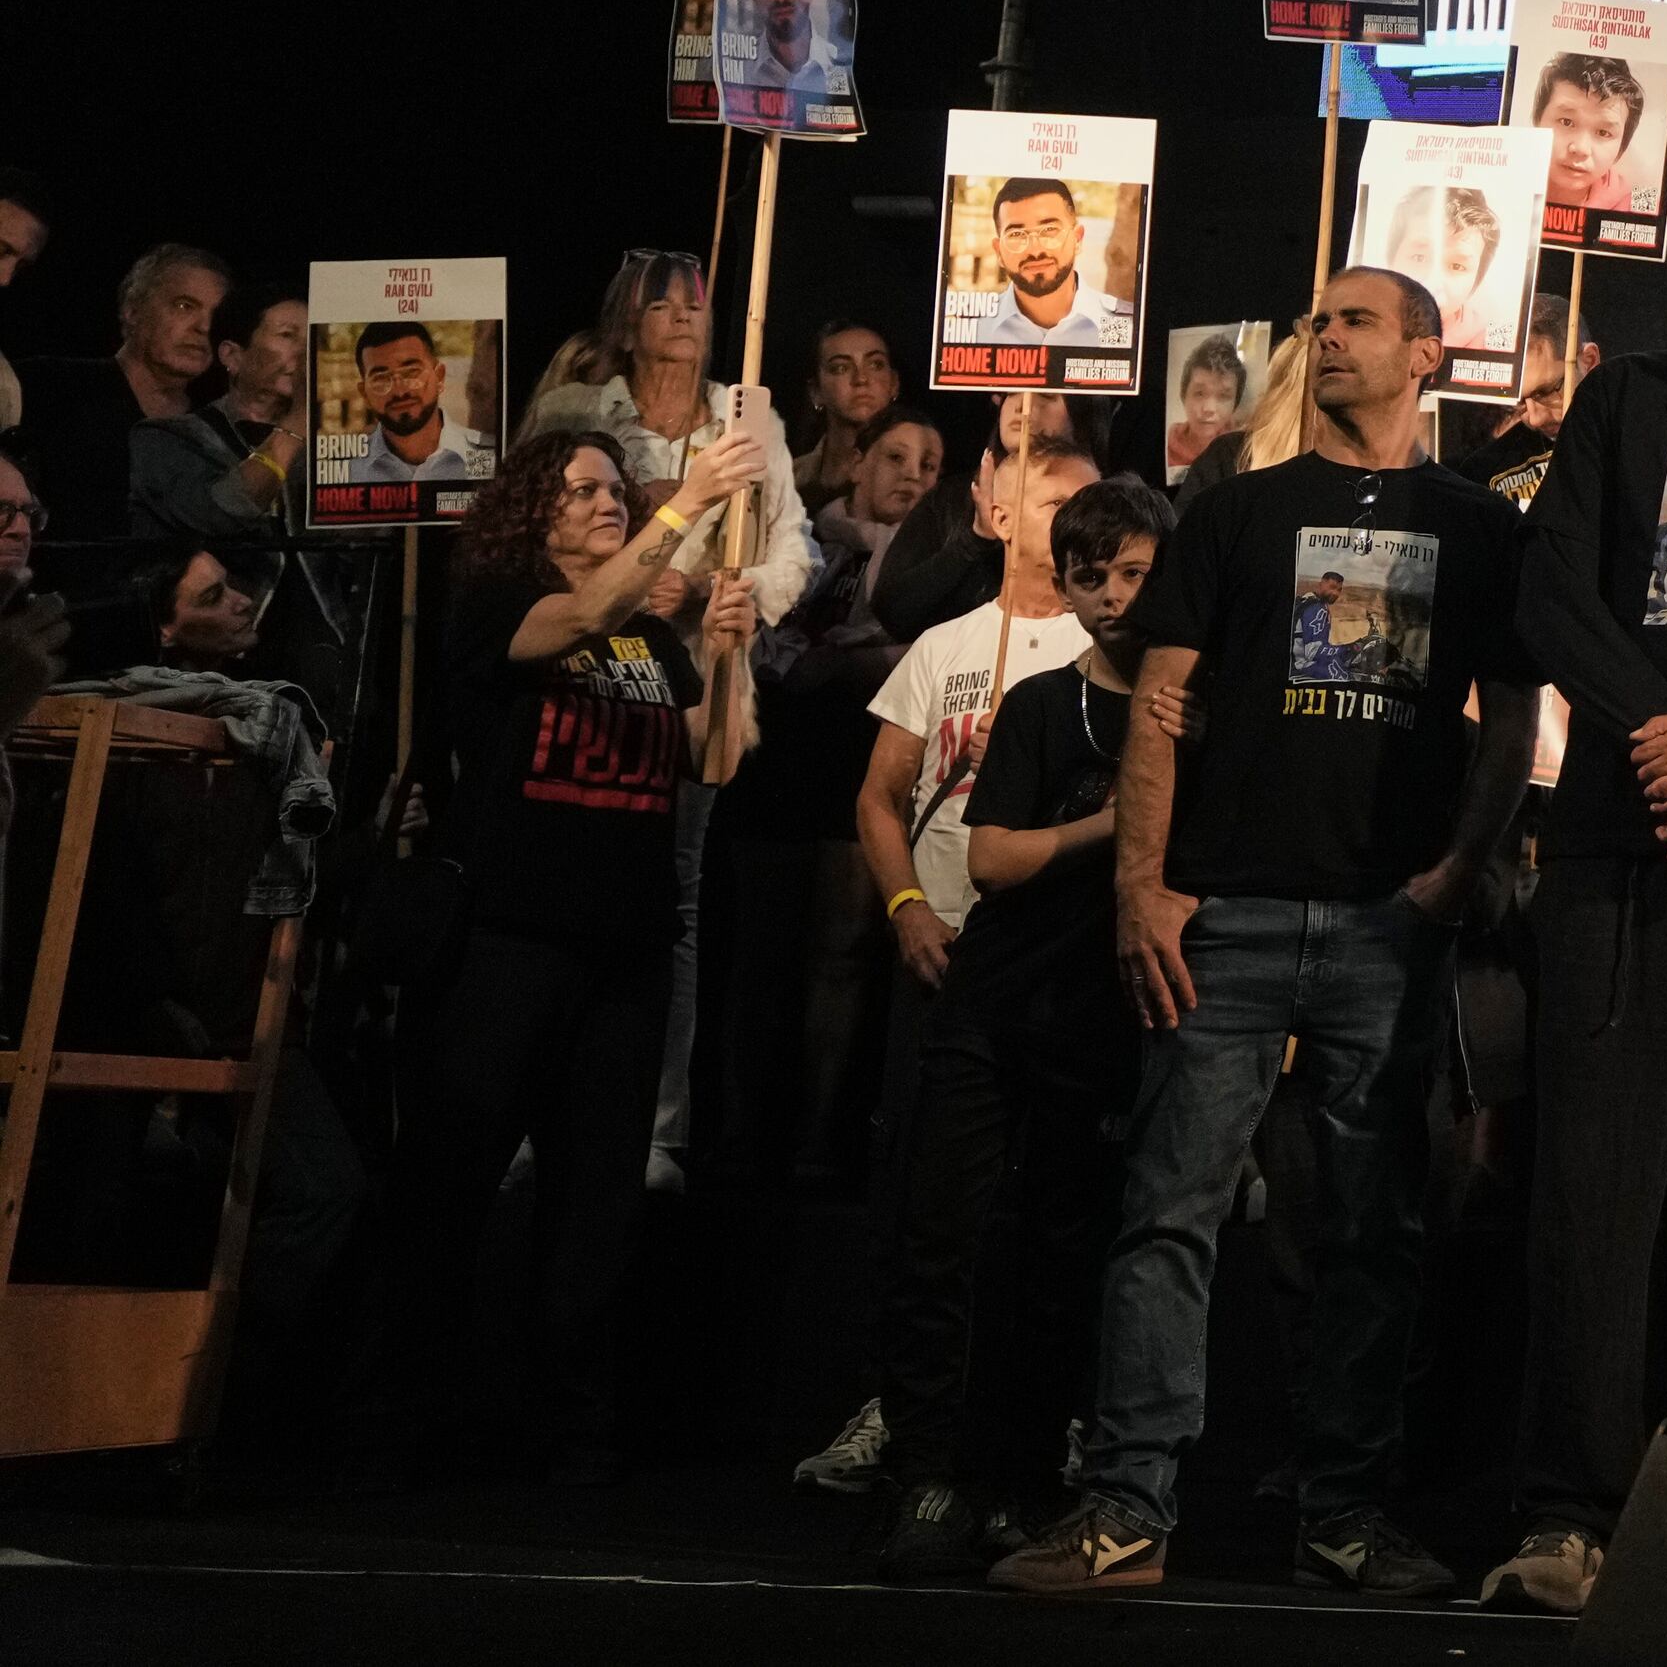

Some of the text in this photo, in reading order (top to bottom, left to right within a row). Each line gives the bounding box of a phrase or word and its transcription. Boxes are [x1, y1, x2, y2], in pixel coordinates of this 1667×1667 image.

[1270, 0, 1351, 28] HOME NOW!
[675, 34, 712, 57] BRING
[721, 32, 757, 60] BRING
[673, 58, 697, 81] HIM
[722, 57, 745, 84] HIM
[945, 291, 999, 318] BRING
[944, 318, 978, 343] HIM
[942, 345, 1047, 374] HOME NOW!
[318, 434, 368, 459] BRING
[318, 460, 350, 484] HIM
[319, 482, 417, 512] HOME NOW!
[1309, 533, 1435, 562] רן גואילי עלומים
[1320, 646, 1339, 655] FOX
[945, 669, 990, 695] BRING
[943, 691, 978, 716] THEM
[1282, 687, 1327, 715] בבית
[1334, 689, 1358, 720] לך
